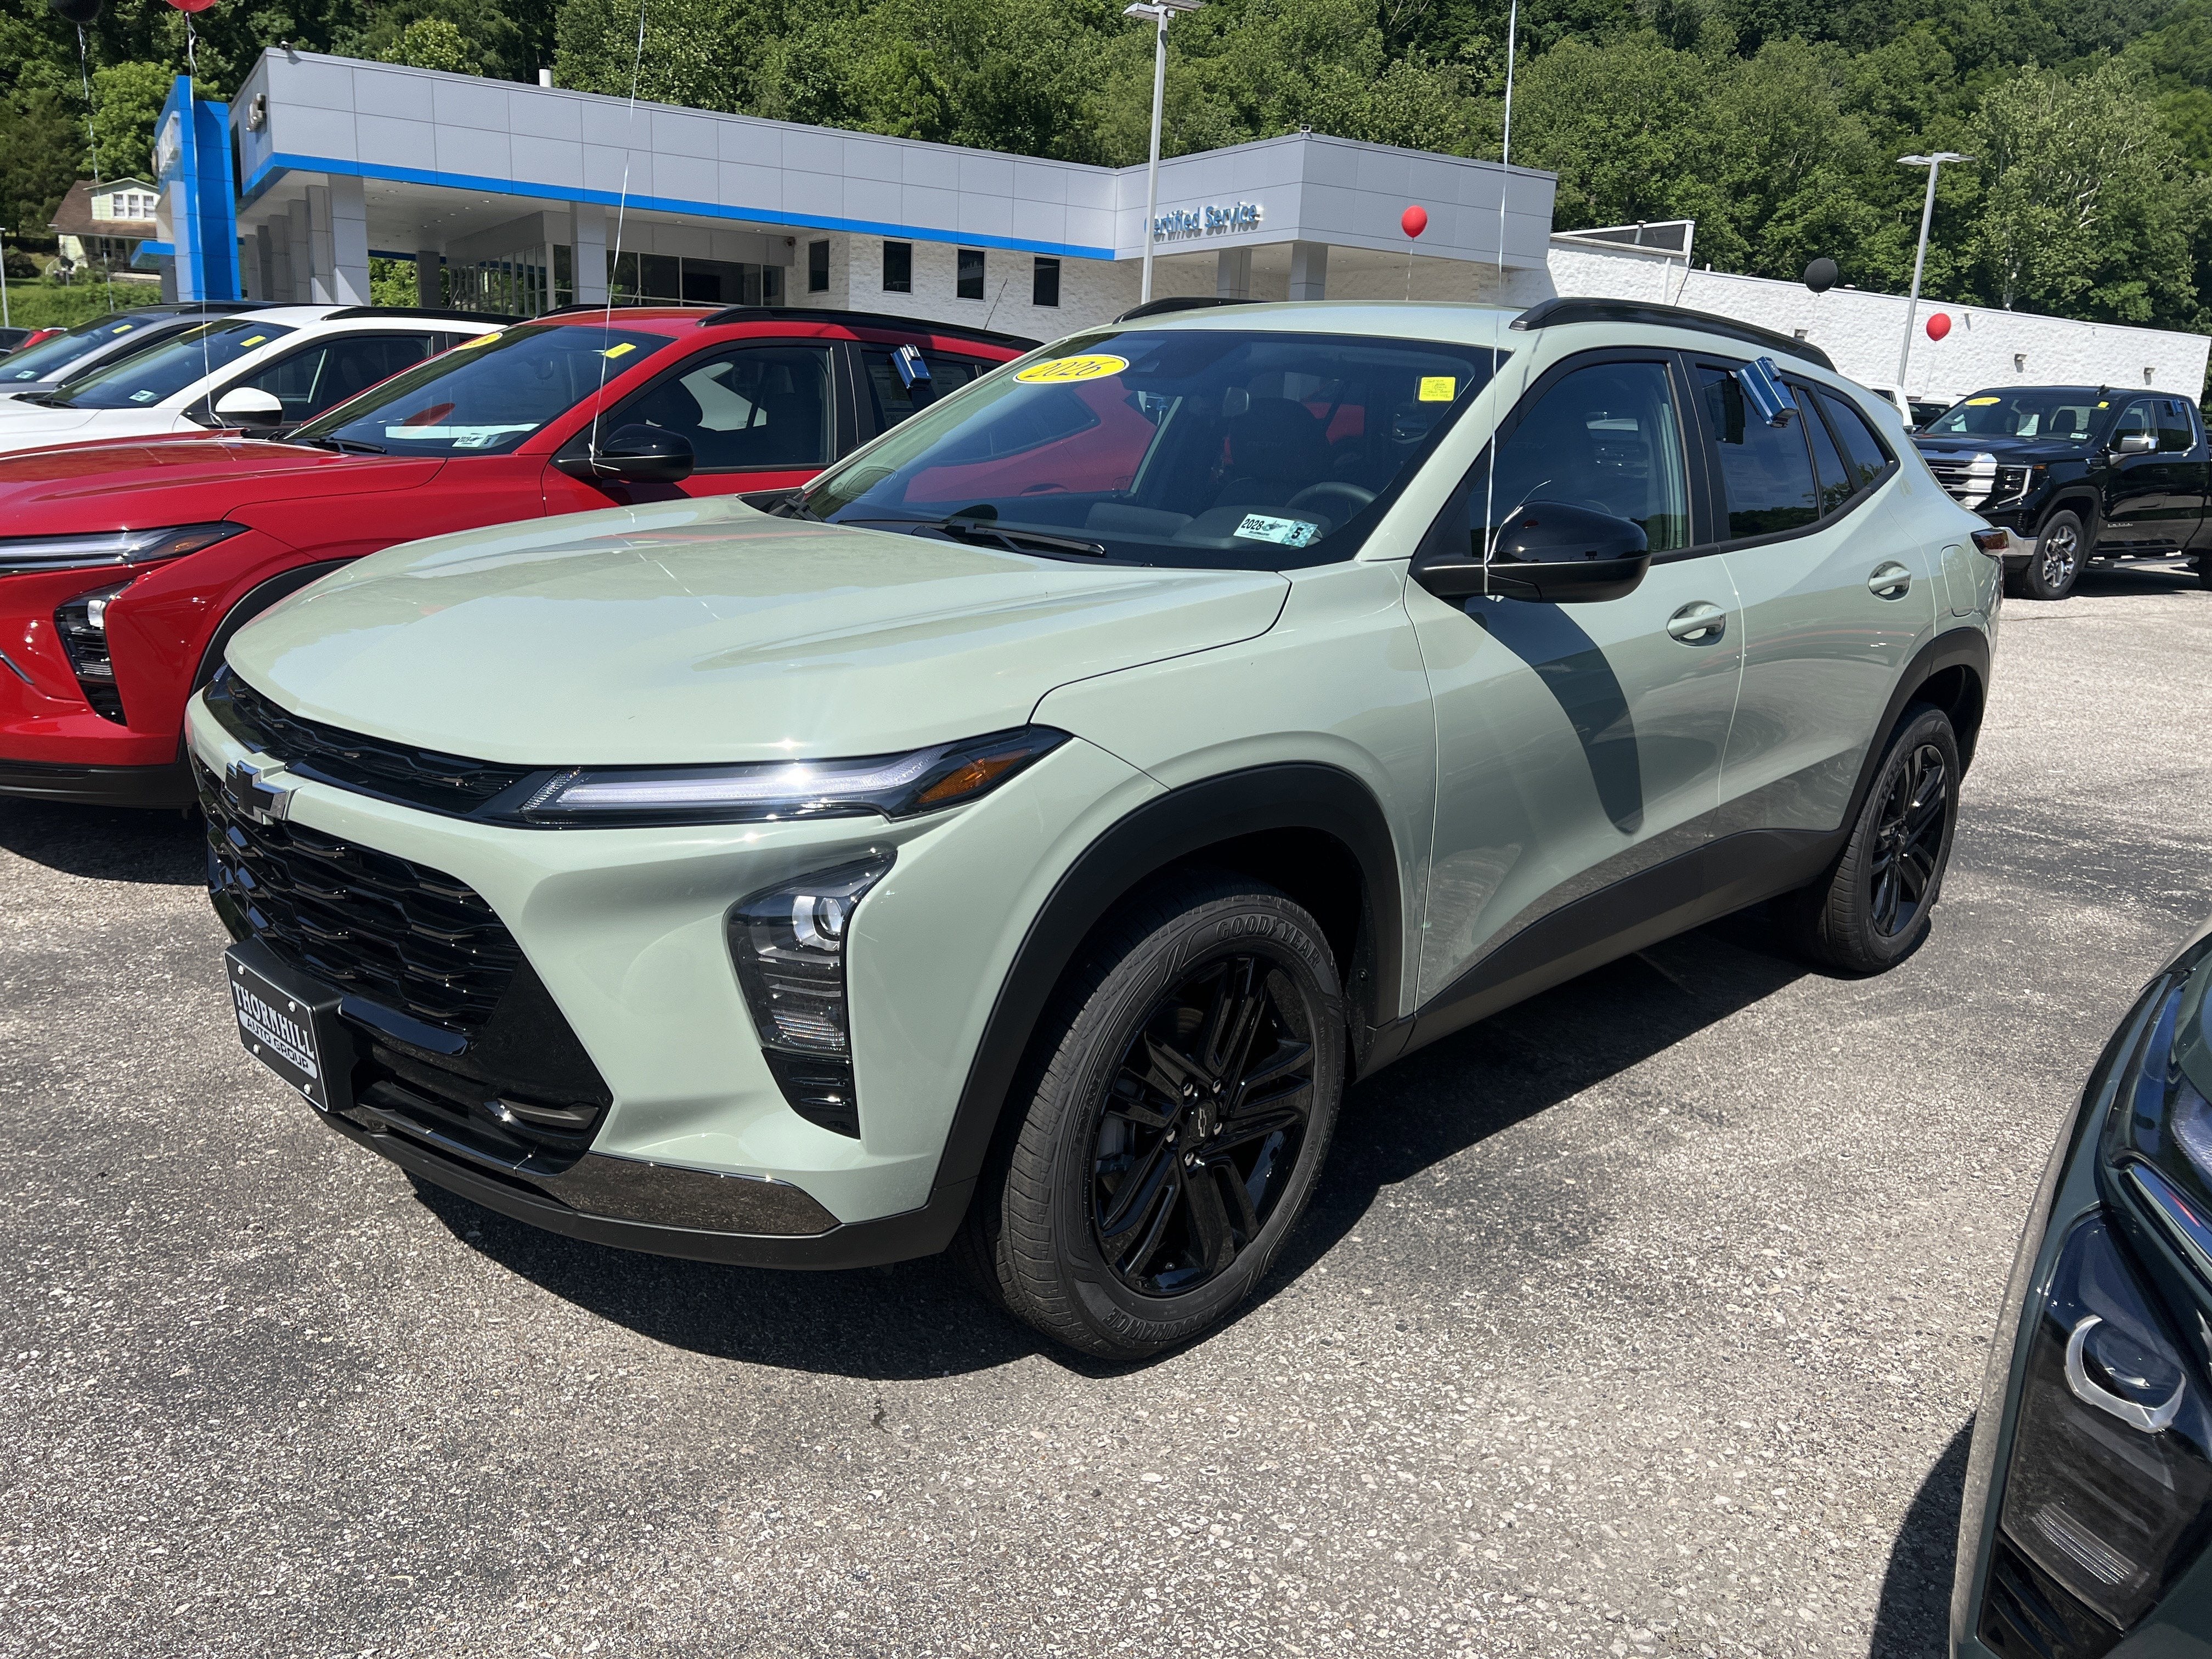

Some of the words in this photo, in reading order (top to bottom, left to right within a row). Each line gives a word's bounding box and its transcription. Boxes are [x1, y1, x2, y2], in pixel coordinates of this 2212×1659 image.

[1144, 207, 1202, 235] ertified
[1205, 201, 1259, 228] Service
[1024, 360, 1116, 378] 2026
[1240, 518, 1265, 531] 2028
[1291, 527, 1304, 539] 5
[232, 980, 315, 1060] THORNHILL
[246, 1016, 271, 1043] AUTO
[274, 1038, 309, 1069] GROUP
